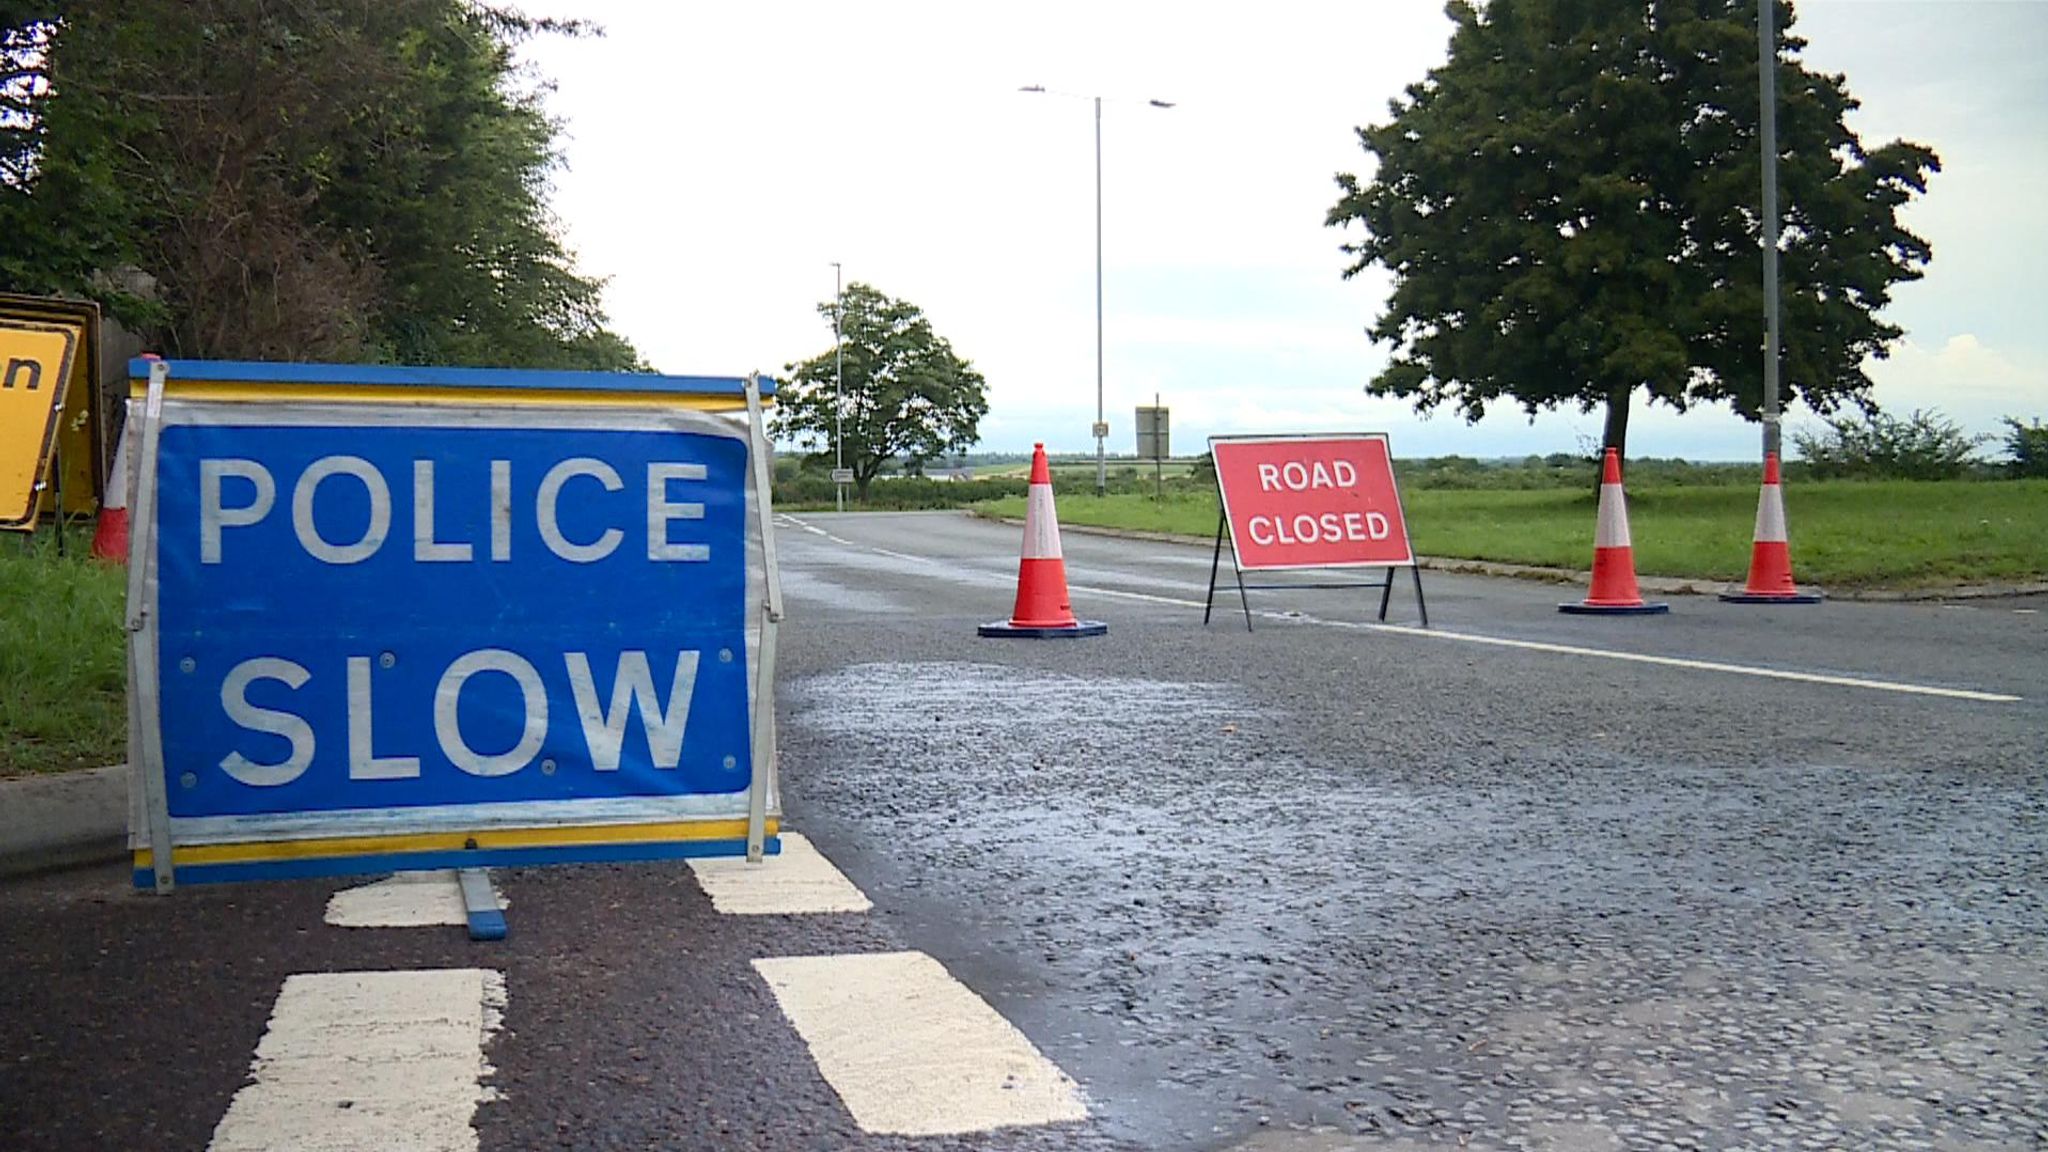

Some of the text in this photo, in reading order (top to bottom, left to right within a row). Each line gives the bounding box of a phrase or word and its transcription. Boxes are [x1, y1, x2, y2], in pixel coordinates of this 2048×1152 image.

[201, 455, 711, 564] POLICE
[1257, 461, 1357, 491] ROAD
[1248, 512, 1390, 545] CLOSED
[219, 650, 700, 787] SLOW
